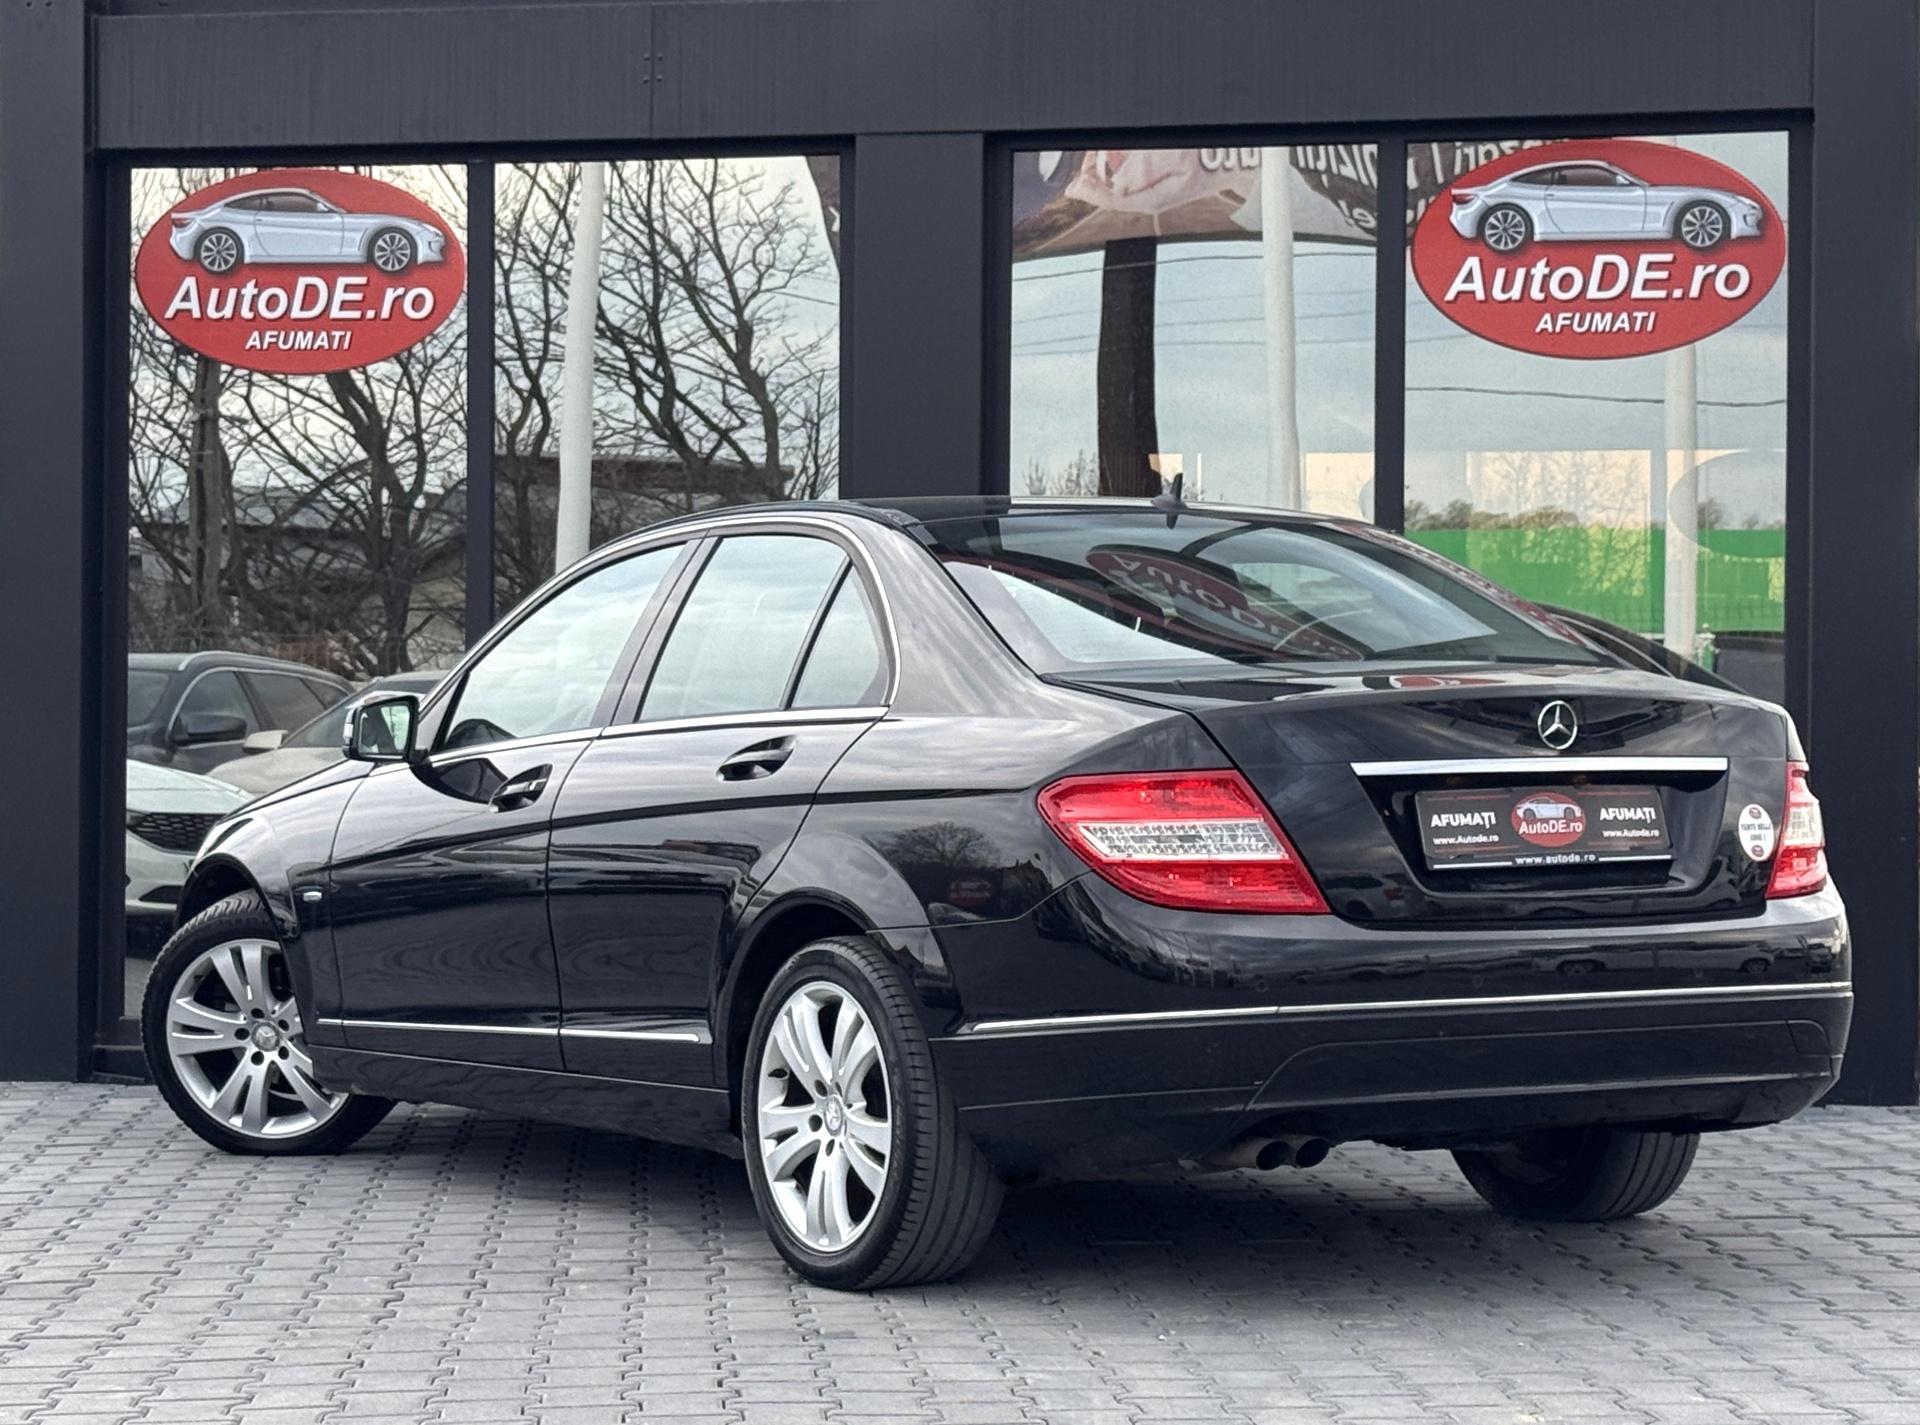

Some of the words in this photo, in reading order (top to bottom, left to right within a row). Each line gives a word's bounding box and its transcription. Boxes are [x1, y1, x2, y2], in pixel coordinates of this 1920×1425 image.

[1444, 252, 1752, 302] AutoDE.ro
[164, 276, 435, 321] AutoDE.ro
[1535, 311, 1657, 334] AFUMATI
[245, 330, 353, 351] AFUMATI
[1518, 819, 1583, 834] AutoDE.ro
[1515, 853, 1596, 865] www.autode.ro
